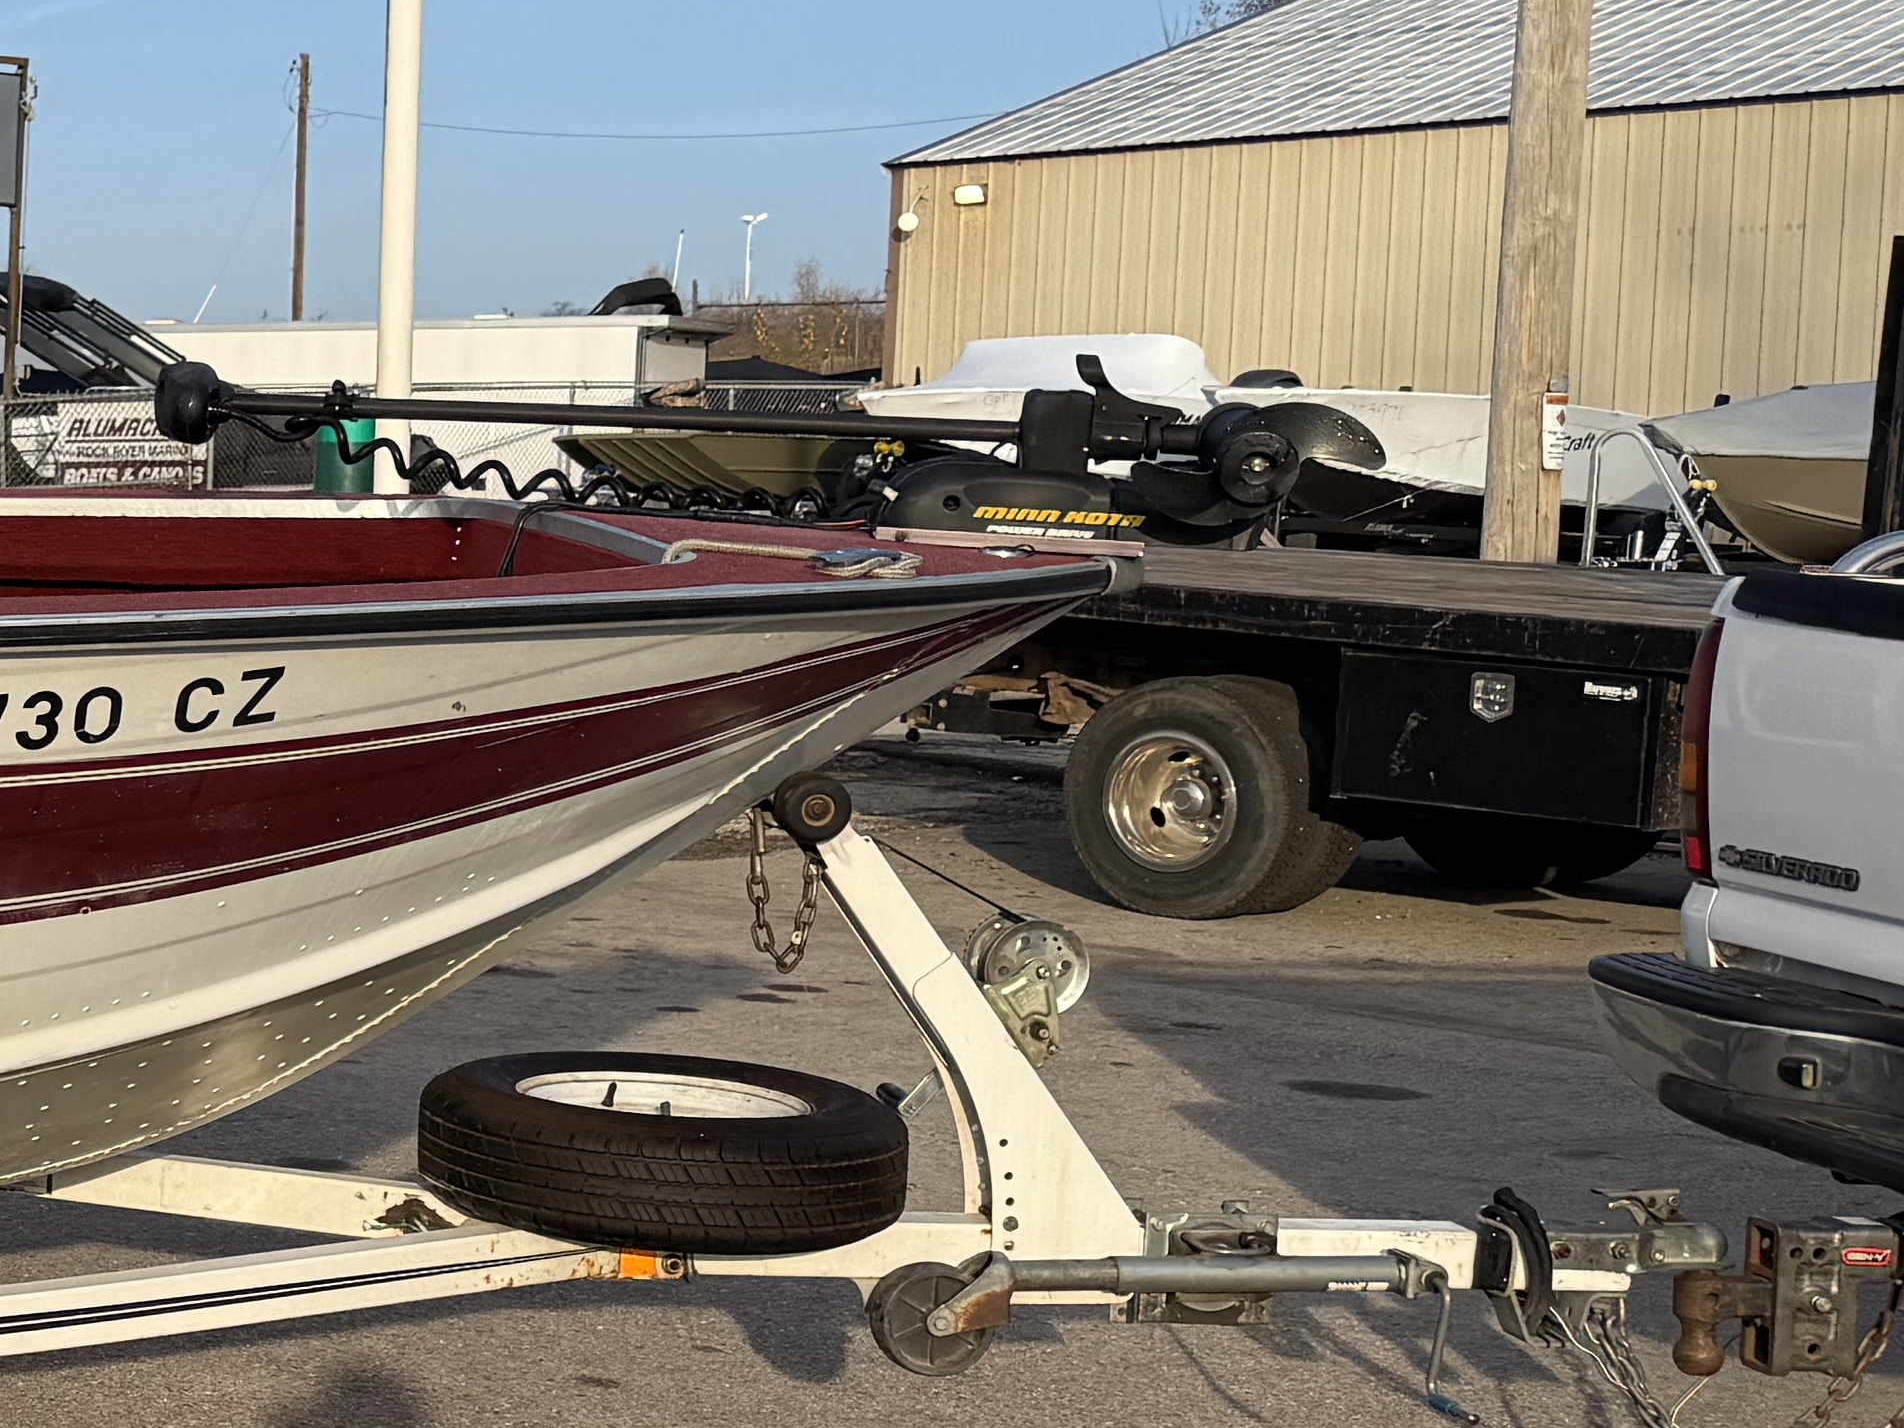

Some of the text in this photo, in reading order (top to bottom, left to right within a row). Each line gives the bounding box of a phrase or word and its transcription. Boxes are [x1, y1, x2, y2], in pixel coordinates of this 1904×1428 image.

[973, 506, 1147, 528] MINN KOTA
[174, 666, 286, 735] CZ
